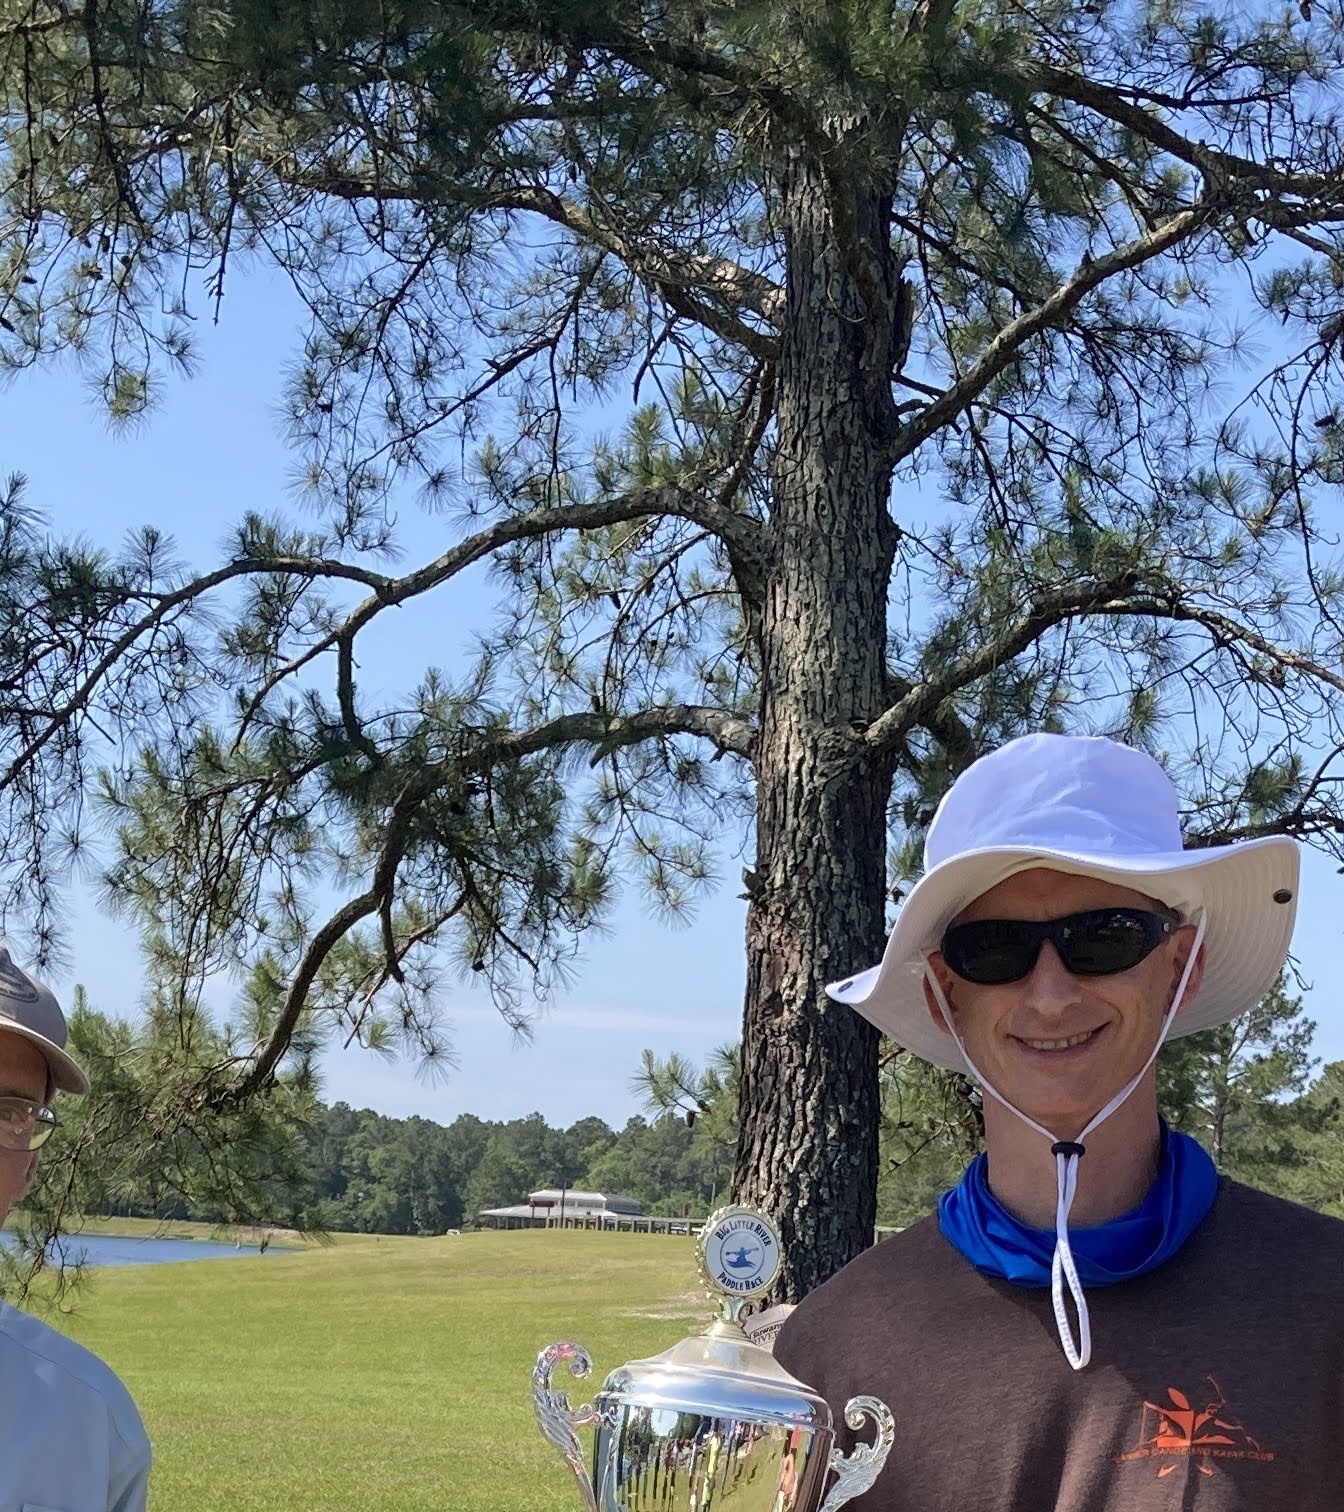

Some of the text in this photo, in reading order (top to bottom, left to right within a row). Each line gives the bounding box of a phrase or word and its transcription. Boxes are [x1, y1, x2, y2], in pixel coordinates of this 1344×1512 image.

[715, 1220, 772, 1247] BIG LITTLE RIVER
[717, 1271, 764, 1291] PADDLE RACE
